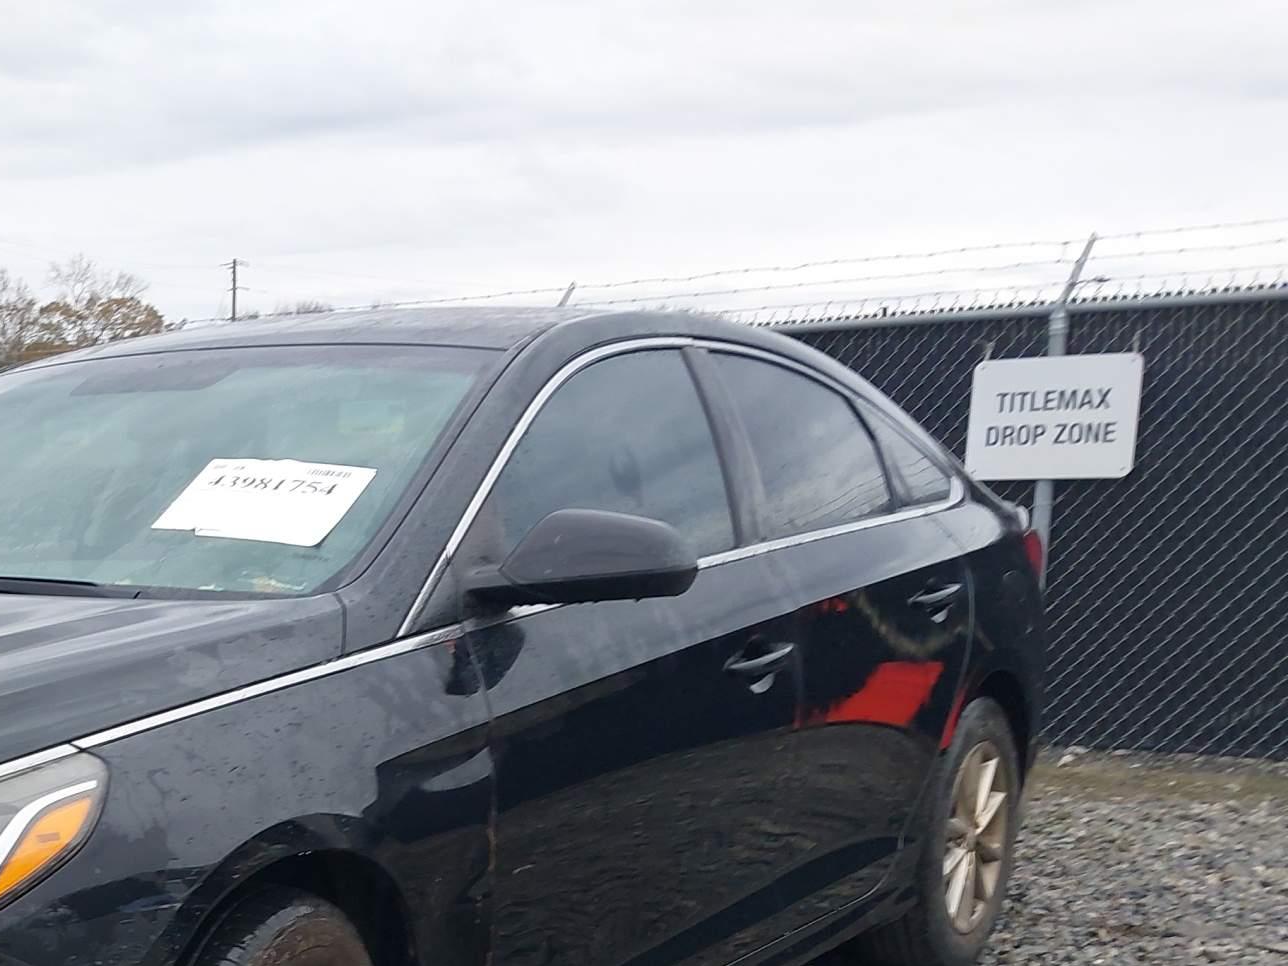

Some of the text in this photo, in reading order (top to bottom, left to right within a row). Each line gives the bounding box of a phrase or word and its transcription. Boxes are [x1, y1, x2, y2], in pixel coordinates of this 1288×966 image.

[996, 387, 1112, 413] TITLEMAX
[985, 421, 1118, 447] DROP ZONE
[208, 474, 338, 496] 43981754
